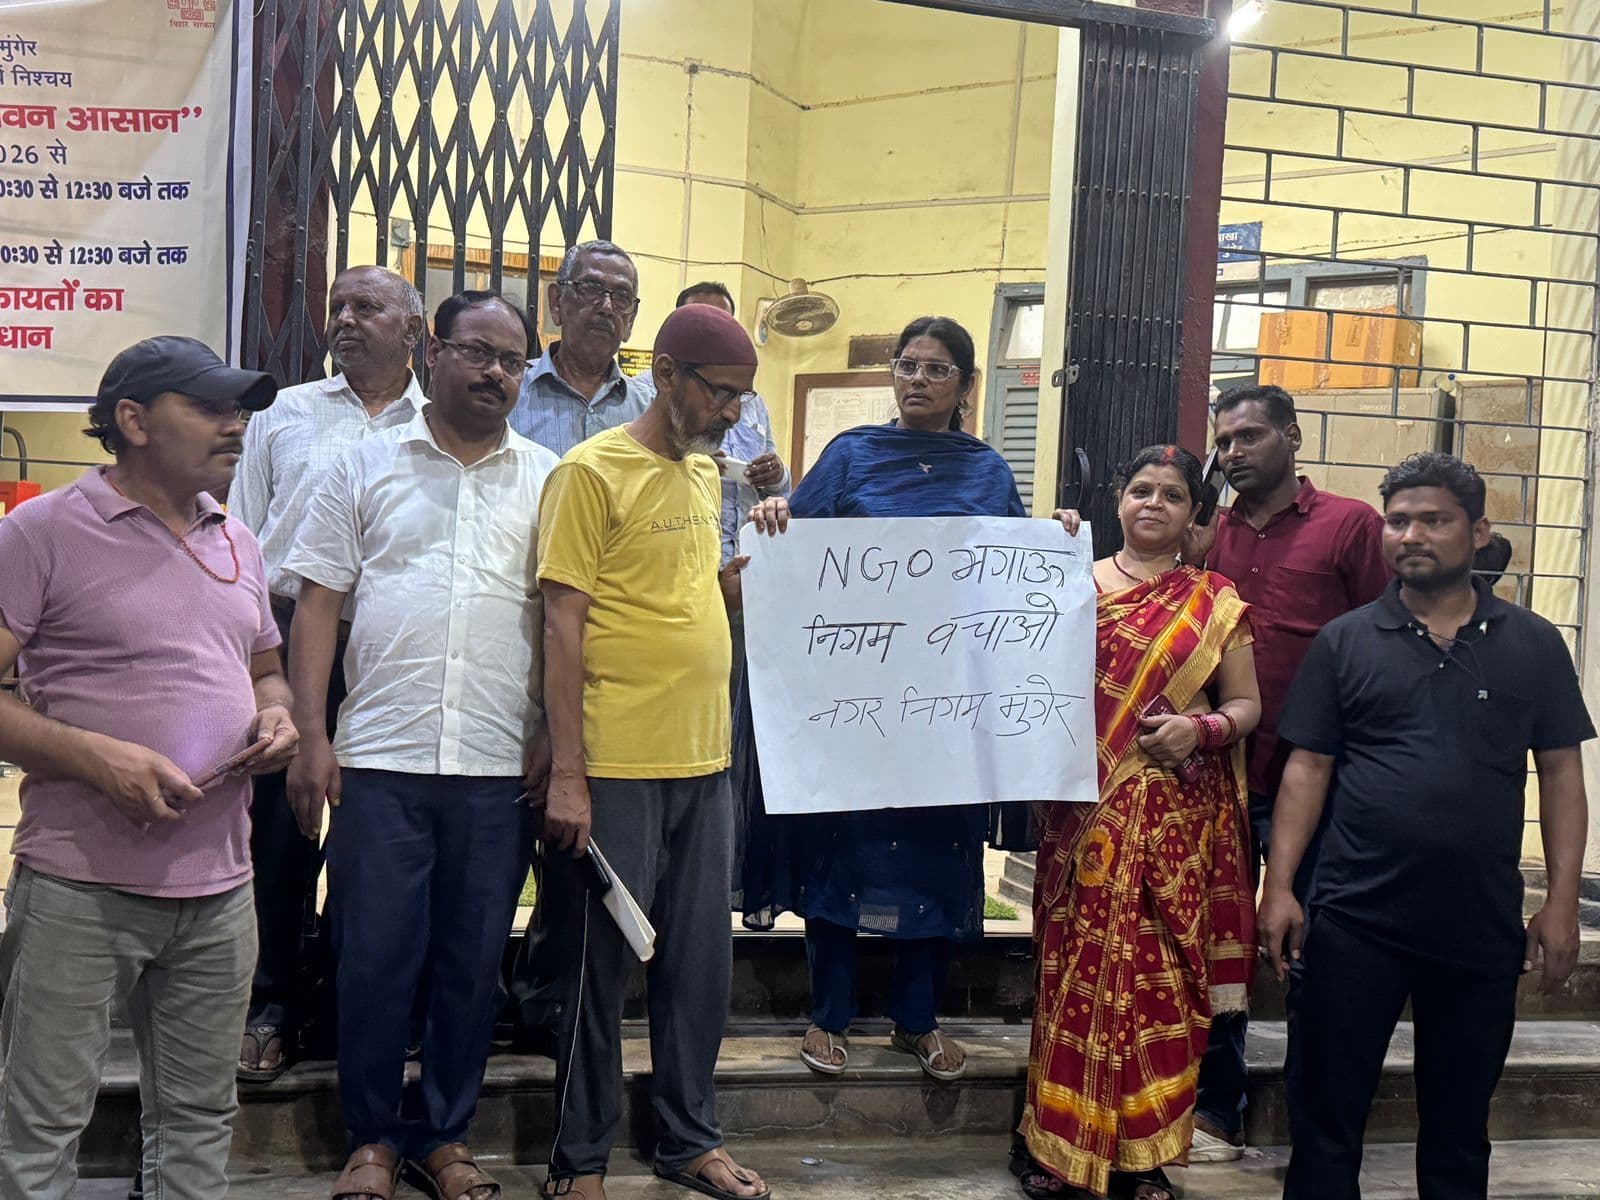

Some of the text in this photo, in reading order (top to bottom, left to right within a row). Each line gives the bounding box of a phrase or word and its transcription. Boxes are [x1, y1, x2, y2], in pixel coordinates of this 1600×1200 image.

[10, 64, 72, 87] निश्चय
[0, 104, 57, 129] वन
[46, 138, 68, 165] से
[38, 173, 59, 199] से
[66, 181, 113, 200] 12:30
[118, 175, 151, 200] बजे
[157, 181, 190, 200] तक
[43, 239, 63, 265] से
[69, 246, 113, 265] 12:30
[118, 240, 151, 265] बजे
[156, 246, 188, 265] तक
[83, 288, 124, 311] का
[819, 547, 934, 593] NGO
[803, 614, 907, 663] निगम
[809, 675, 1087, 747] नगर निगम मुंगेर
